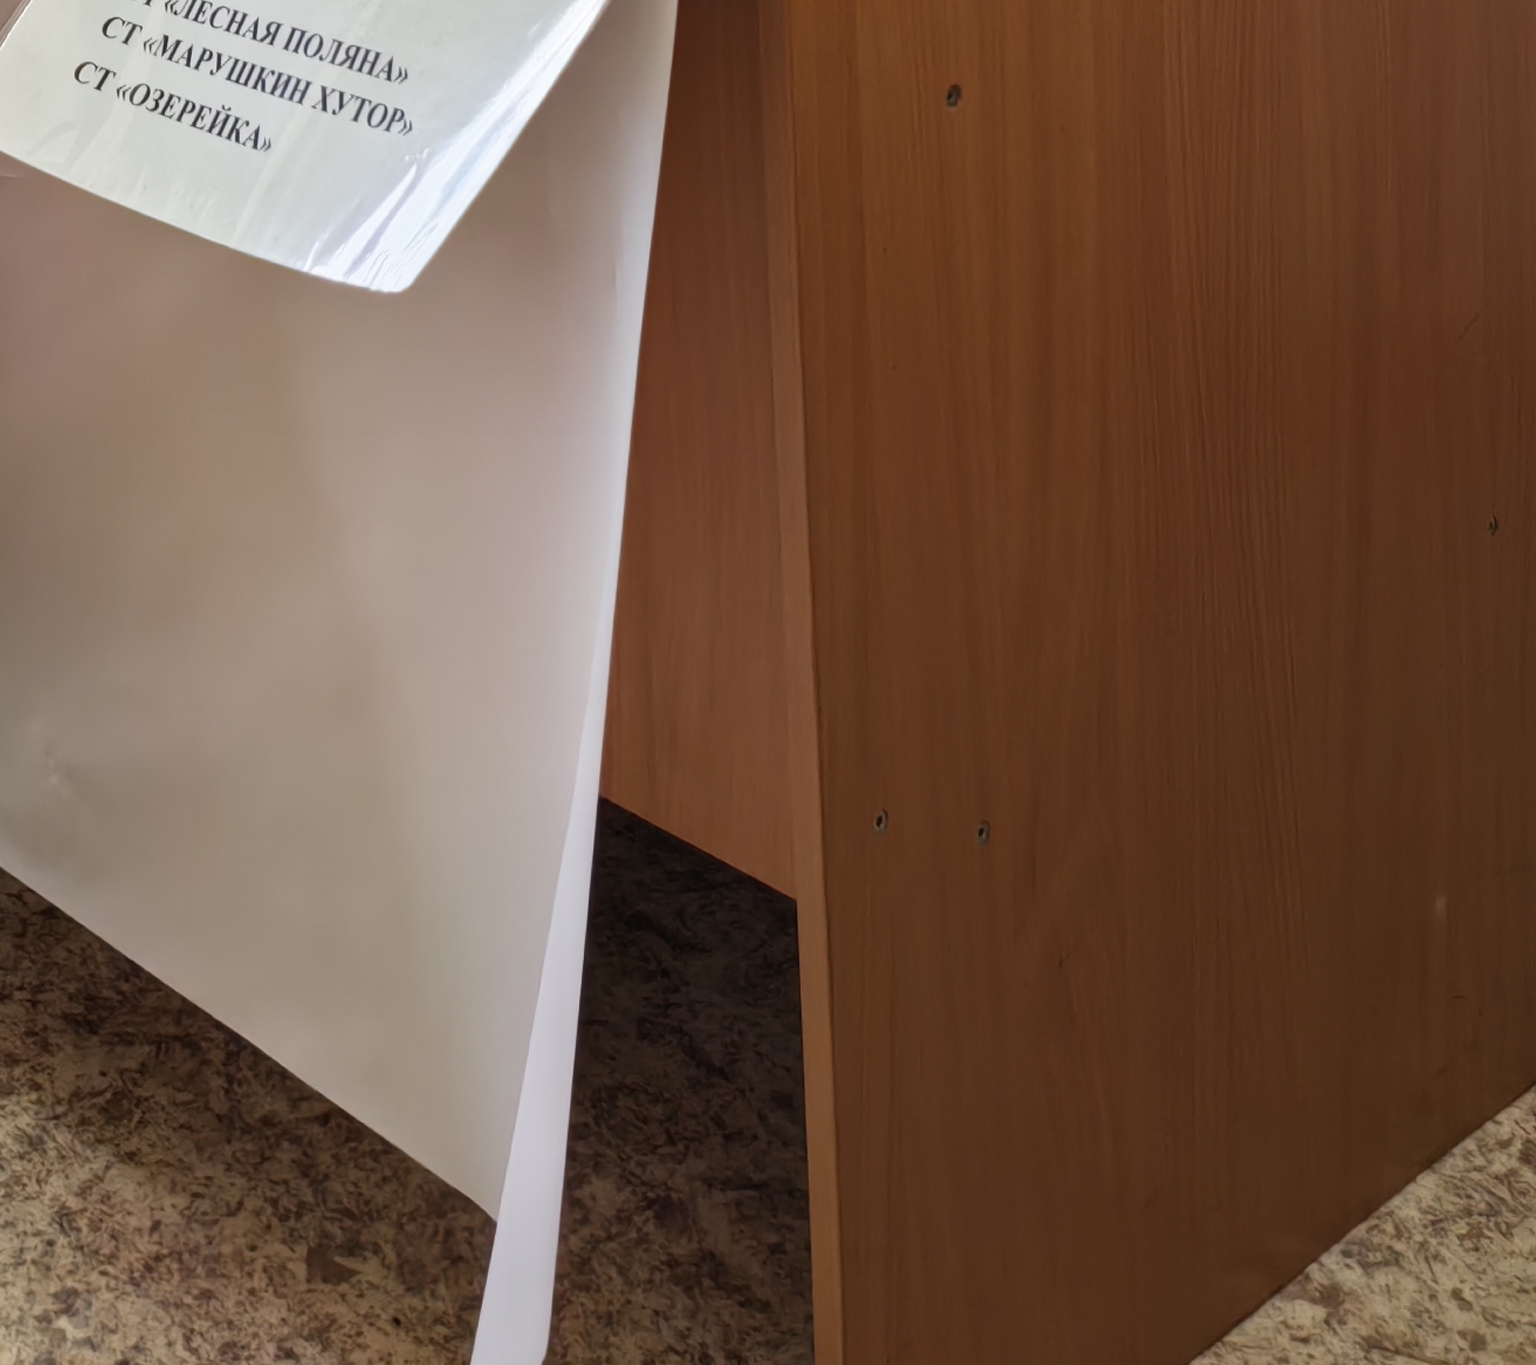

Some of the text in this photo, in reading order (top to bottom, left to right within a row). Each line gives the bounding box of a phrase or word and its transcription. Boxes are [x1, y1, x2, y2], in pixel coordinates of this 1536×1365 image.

[101, 15, 413, 139] СТ «МАРУШКИН ХУТОР»
[284, 27, 409, 86] ПОЛЯНА»
[72, 60, 273, 155] СТ «ОЗЕРЕЙКА»
